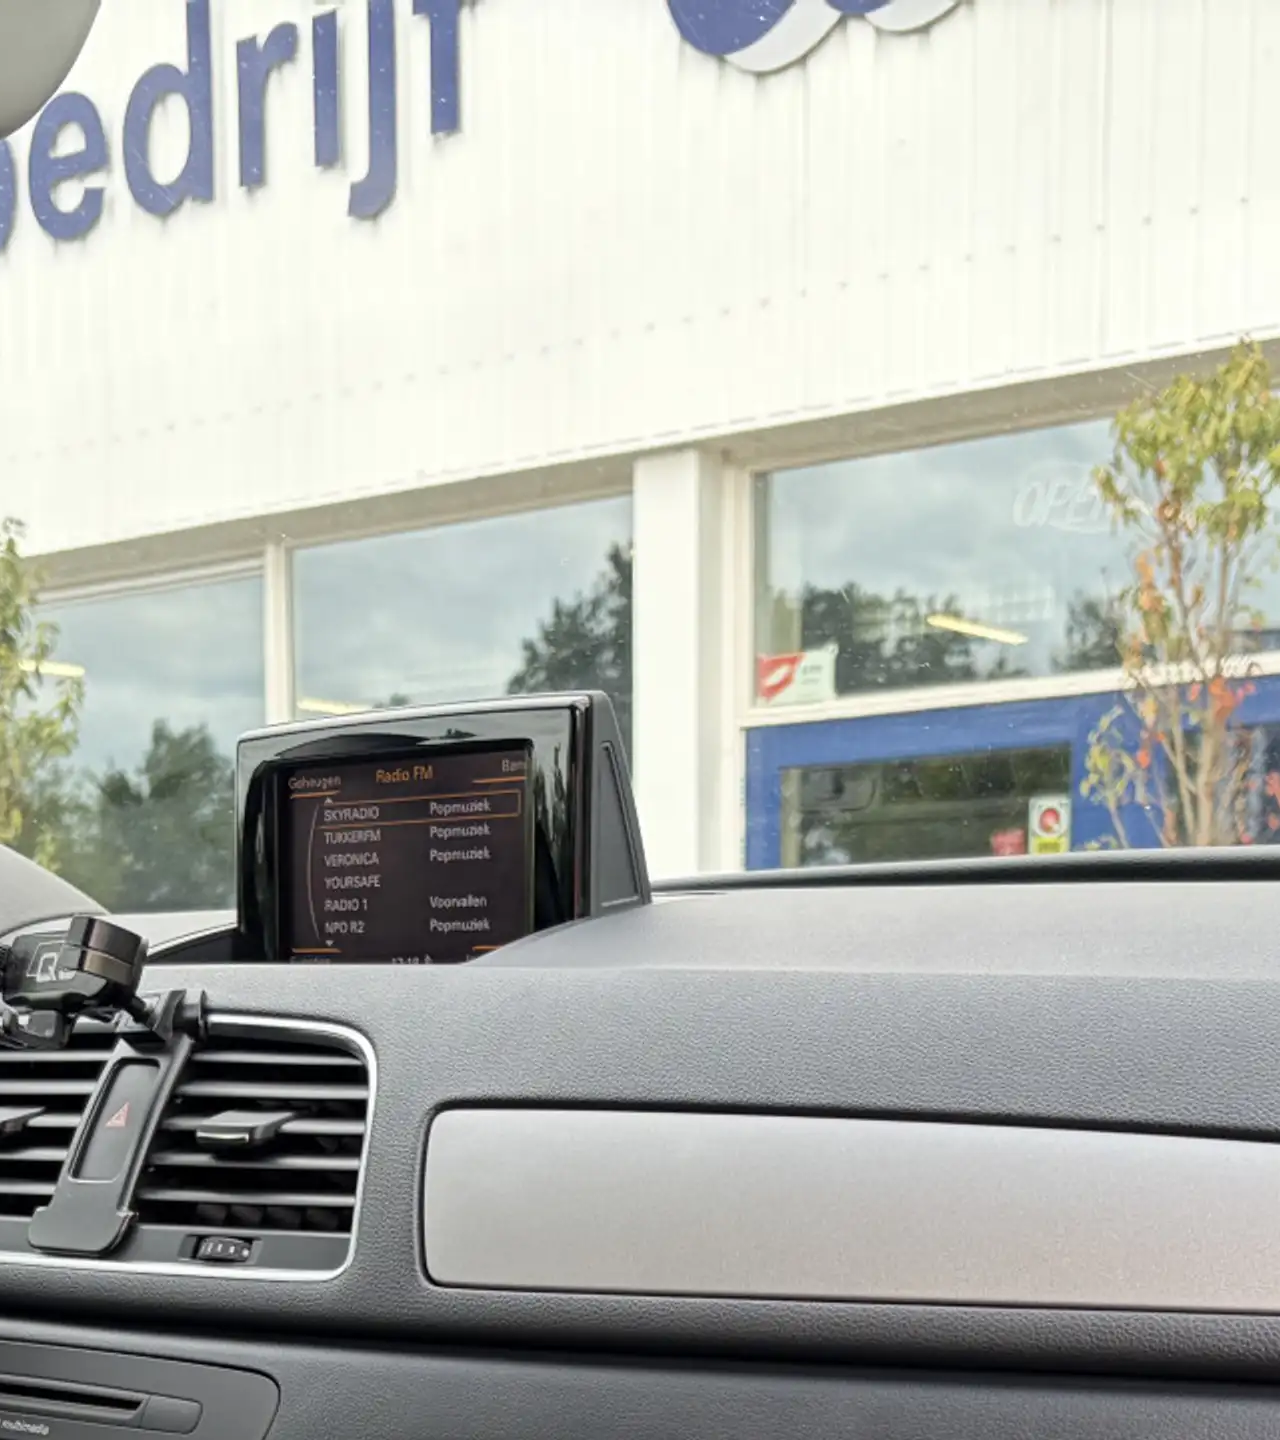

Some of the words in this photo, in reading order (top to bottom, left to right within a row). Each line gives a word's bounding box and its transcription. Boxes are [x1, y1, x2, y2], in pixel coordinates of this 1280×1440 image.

[375, 767, 410, 784] Radio
[413, 764, 433, 781] FM
[324, 805, 380, 821] SKYRADIO
[429, 797, 491, 816] Popmuziek
[429, 821, 491, 840] Popmuziek
[324, 851, 380, 867] VERONICA
[429, 845, 491, 863] Popmuziek
[324, 873, 381, 890] YOURSAFE
[324, 898, 360, 912] RADIO
[325, 920, 347, 934] NPO
[349, 919, 365, 934] R2
[429, 917, 490, 935] Popmuziek
